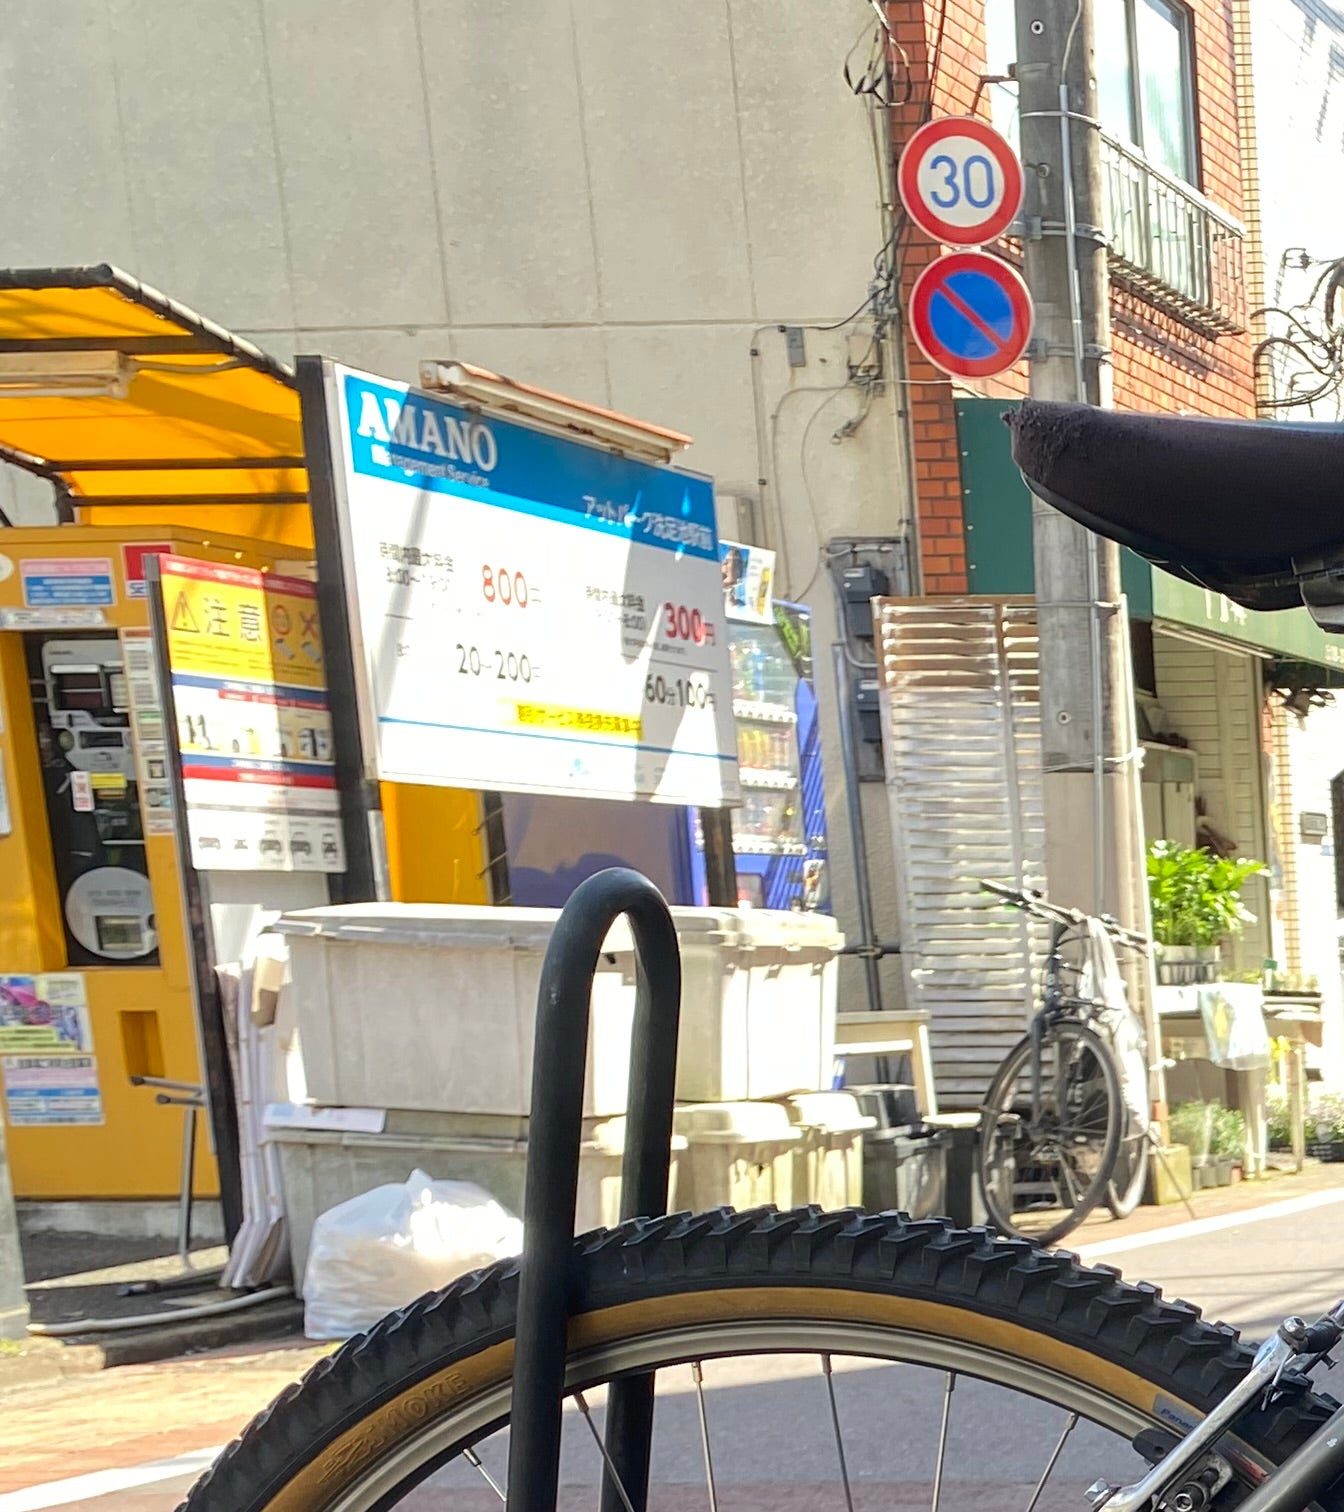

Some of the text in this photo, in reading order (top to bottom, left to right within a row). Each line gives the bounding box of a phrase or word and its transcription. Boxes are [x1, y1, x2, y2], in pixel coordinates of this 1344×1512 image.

[930, 155, 995, 209] 30
[357, 390, 498, 472] AMANO
[203, 596, 263, 642] 注意
[1160, 1407, 1201, 1432] Panar
